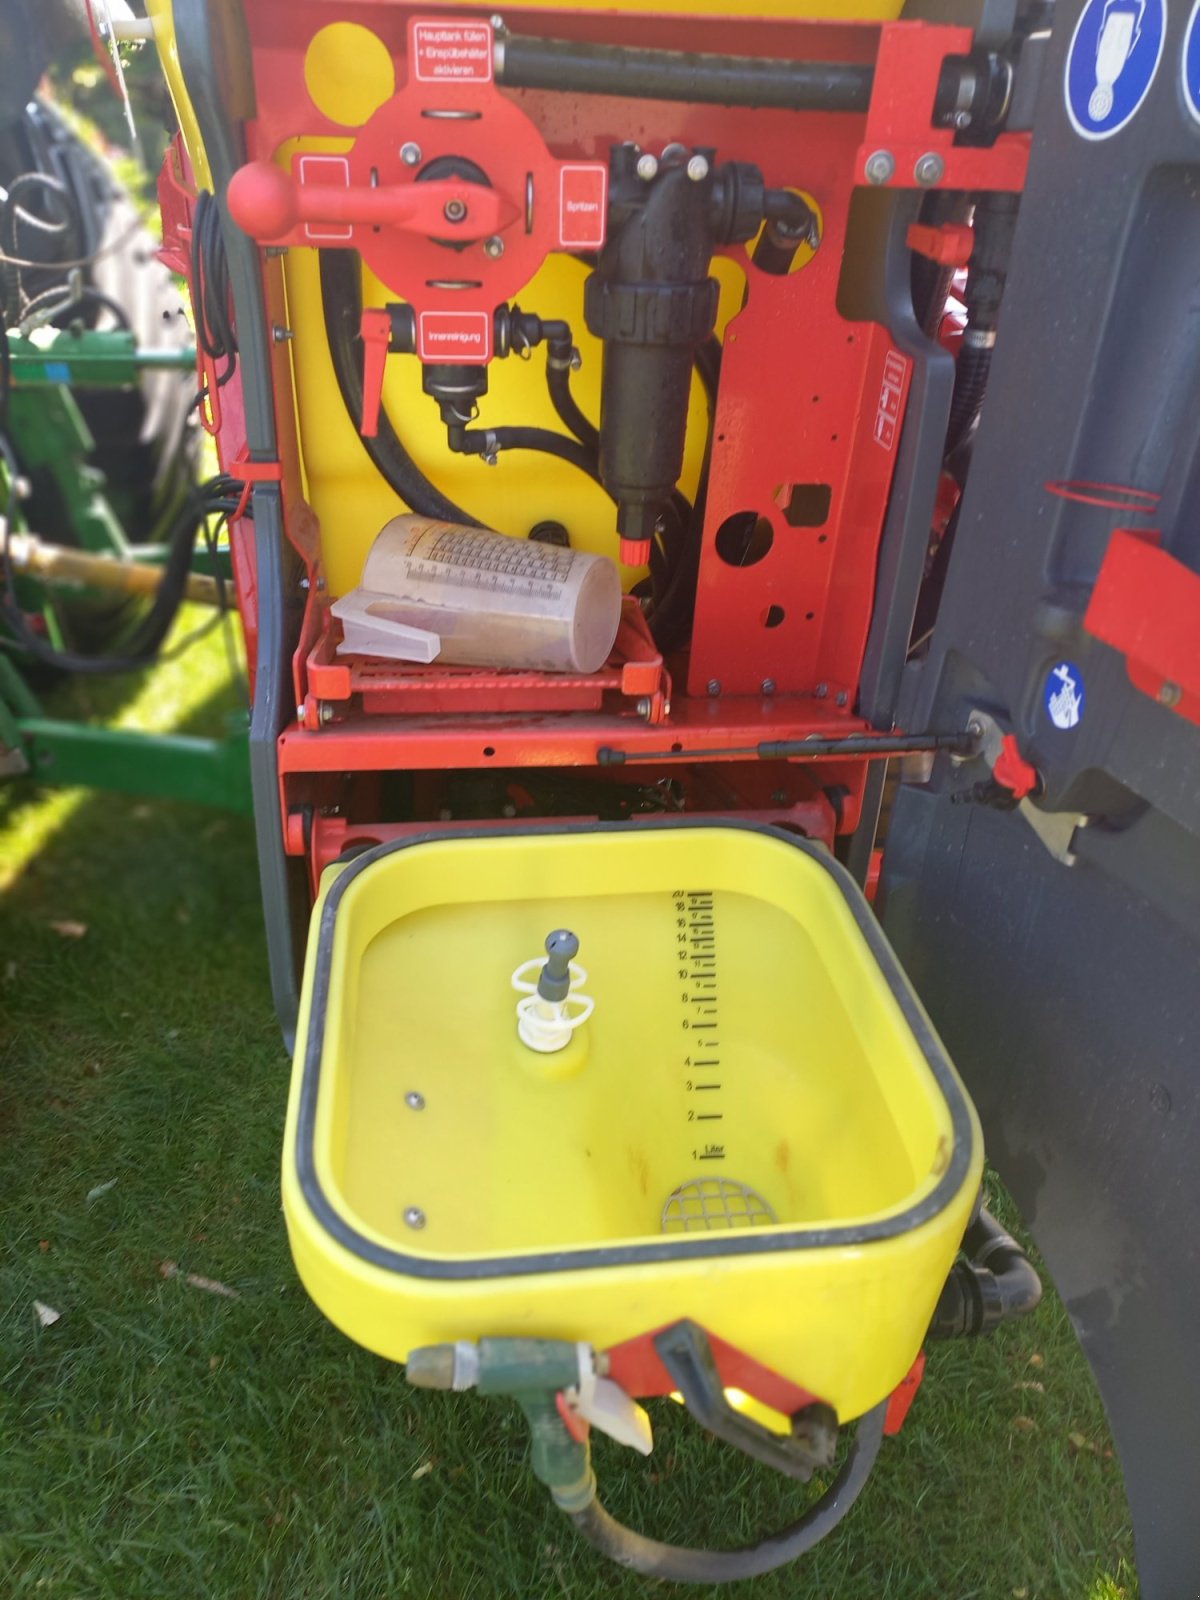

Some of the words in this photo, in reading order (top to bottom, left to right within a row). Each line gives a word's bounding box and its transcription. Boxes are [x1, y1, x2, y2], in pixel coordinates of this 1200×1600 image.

[433, 64, 474, 76] aktivieren
[566, 200, 599, 213] Spritzen
[428, 331, 481, 344] Innenreinigung
[676, 933, 687, 943] 14
[678, 950, 687, 960] 12
[678, 970, 688, 979] 10
[682, 993, 688, 1003] 8
[682, 1019, 689, 1030] 6
[684, 1056, 691, 1067] 4
[686, 1080, 693, 1091] 3
[687, 1110, 695, 1121] 2
[704, 1143, 725, 1155] Liter
[691, 1150, 698, 1161] 1
